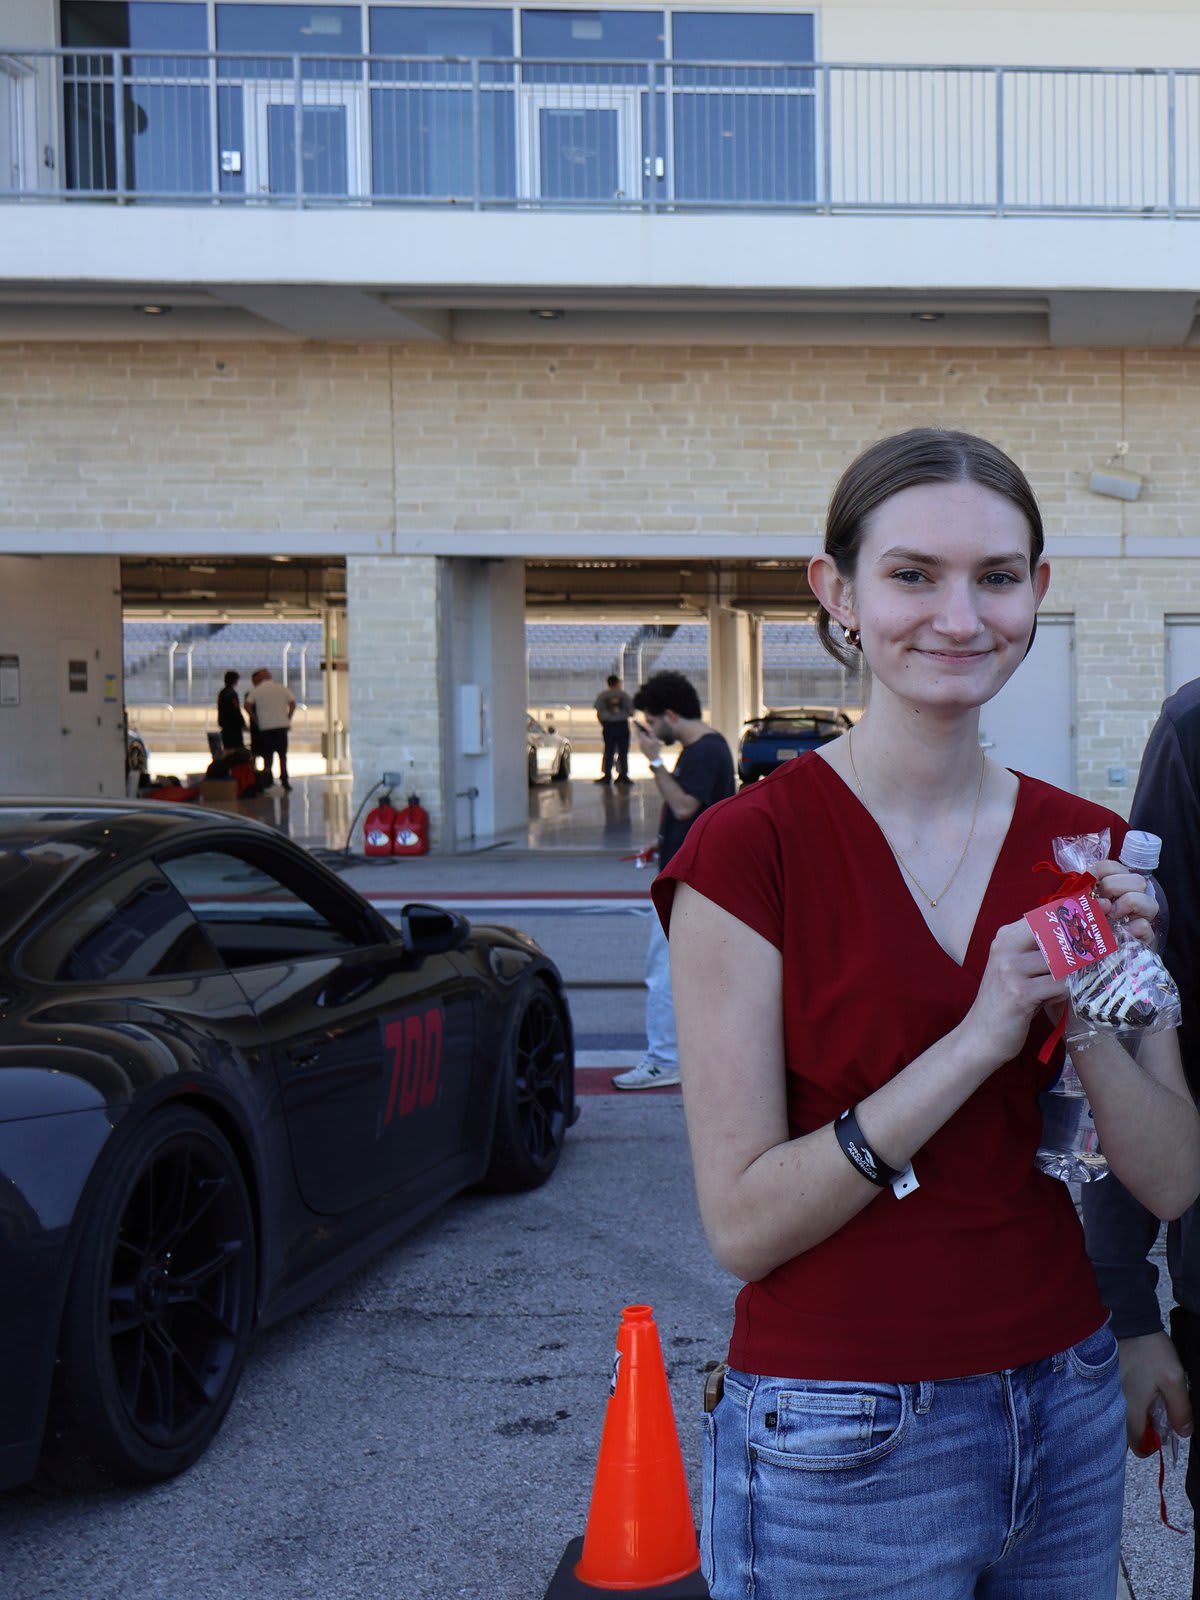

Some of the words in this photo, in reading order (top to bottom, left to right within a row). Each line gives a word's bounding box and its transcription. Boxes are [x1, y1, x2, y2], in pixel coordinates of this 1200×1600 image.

[1045, 911, 1059, 923] A
[1053, 926, 1077, 967] Thrill
[1079, 894, 1095, 923] YOU'RE
[1091, 923, 1107, 955] ALWAYS
[849, 1141, 871, 1169] CIRCUIT
